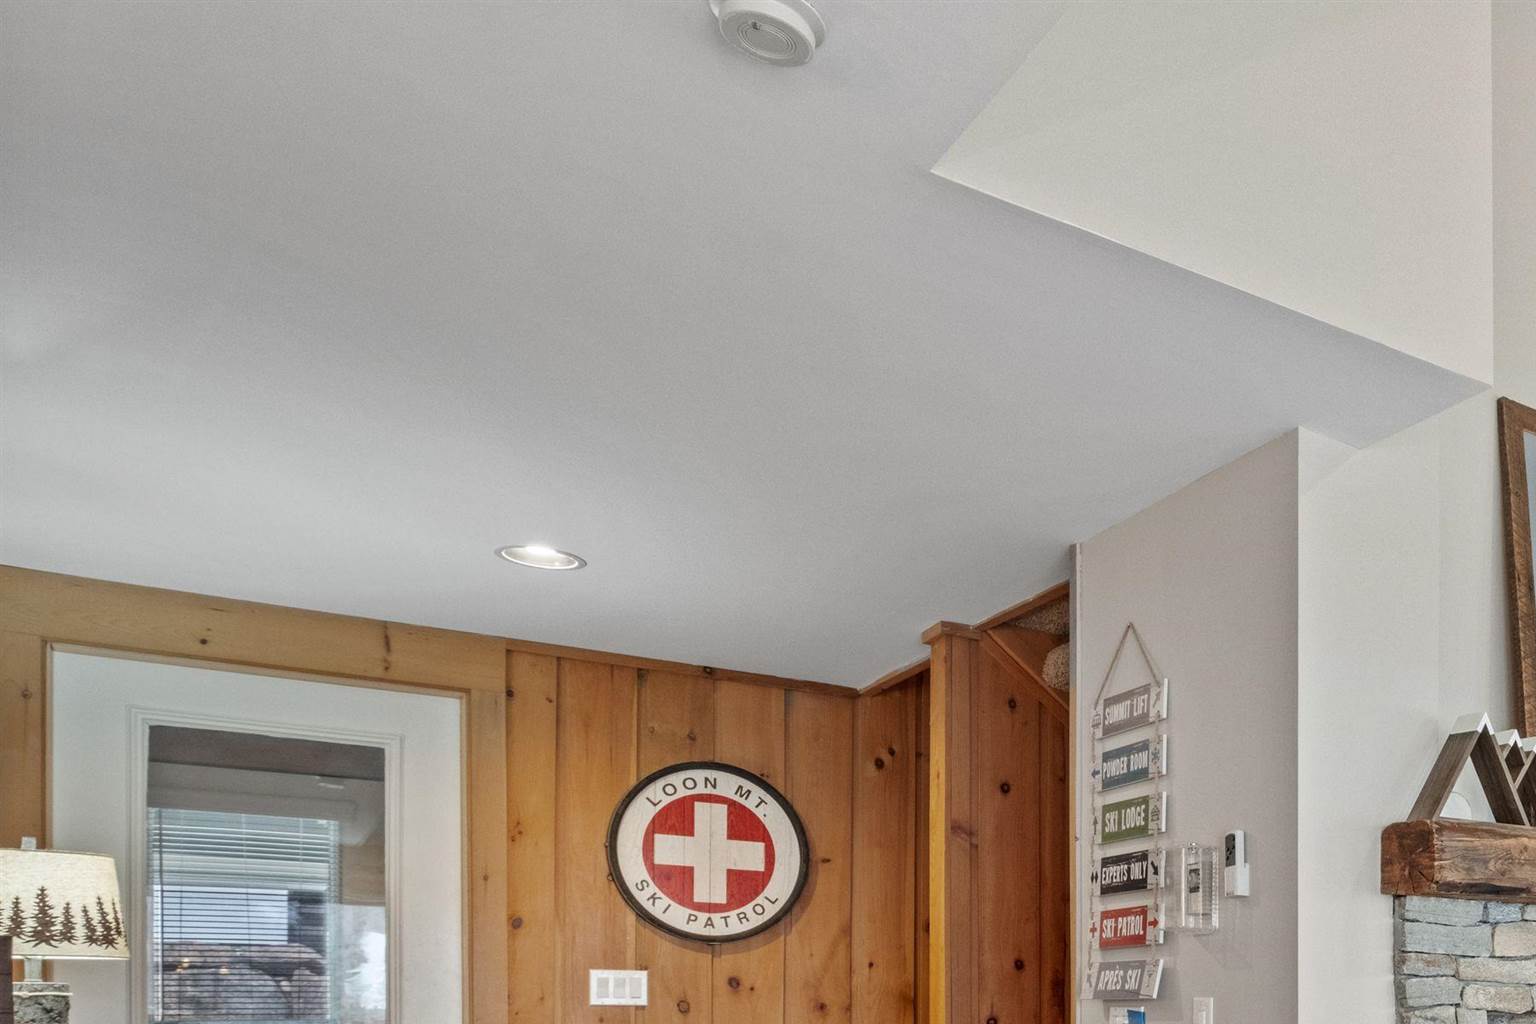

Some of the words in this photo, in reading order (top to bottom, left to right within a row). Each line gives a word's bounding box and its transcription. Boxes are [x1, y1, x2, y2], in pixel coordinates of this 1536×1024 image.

[1104, 700, 1131, 725] SUMMIT
[1132, 694, 1149, 716] LIFT
[1102, 757, 1129, 779] POWDER
[1130, 750, 1149, 772] ROOM
[646, 777, 717, 807] LOON
[734, 784, 768, 817] MT.
[1104, 810, 1118, 833] SKI
[1121, 804, 1146, 830] LODGE
[1101, 864, 1128, 885] EXPERTS
[1129, 860, 1147, 881] ONLY
[635, 879, 671, 914] SKI
[686, 895, 779, 929] PATROL
[1102, 918, 1115, 939] SKI
[1117, 914, 1144, 937] PATROL
[1124, 968, 1142, 990] SKI
